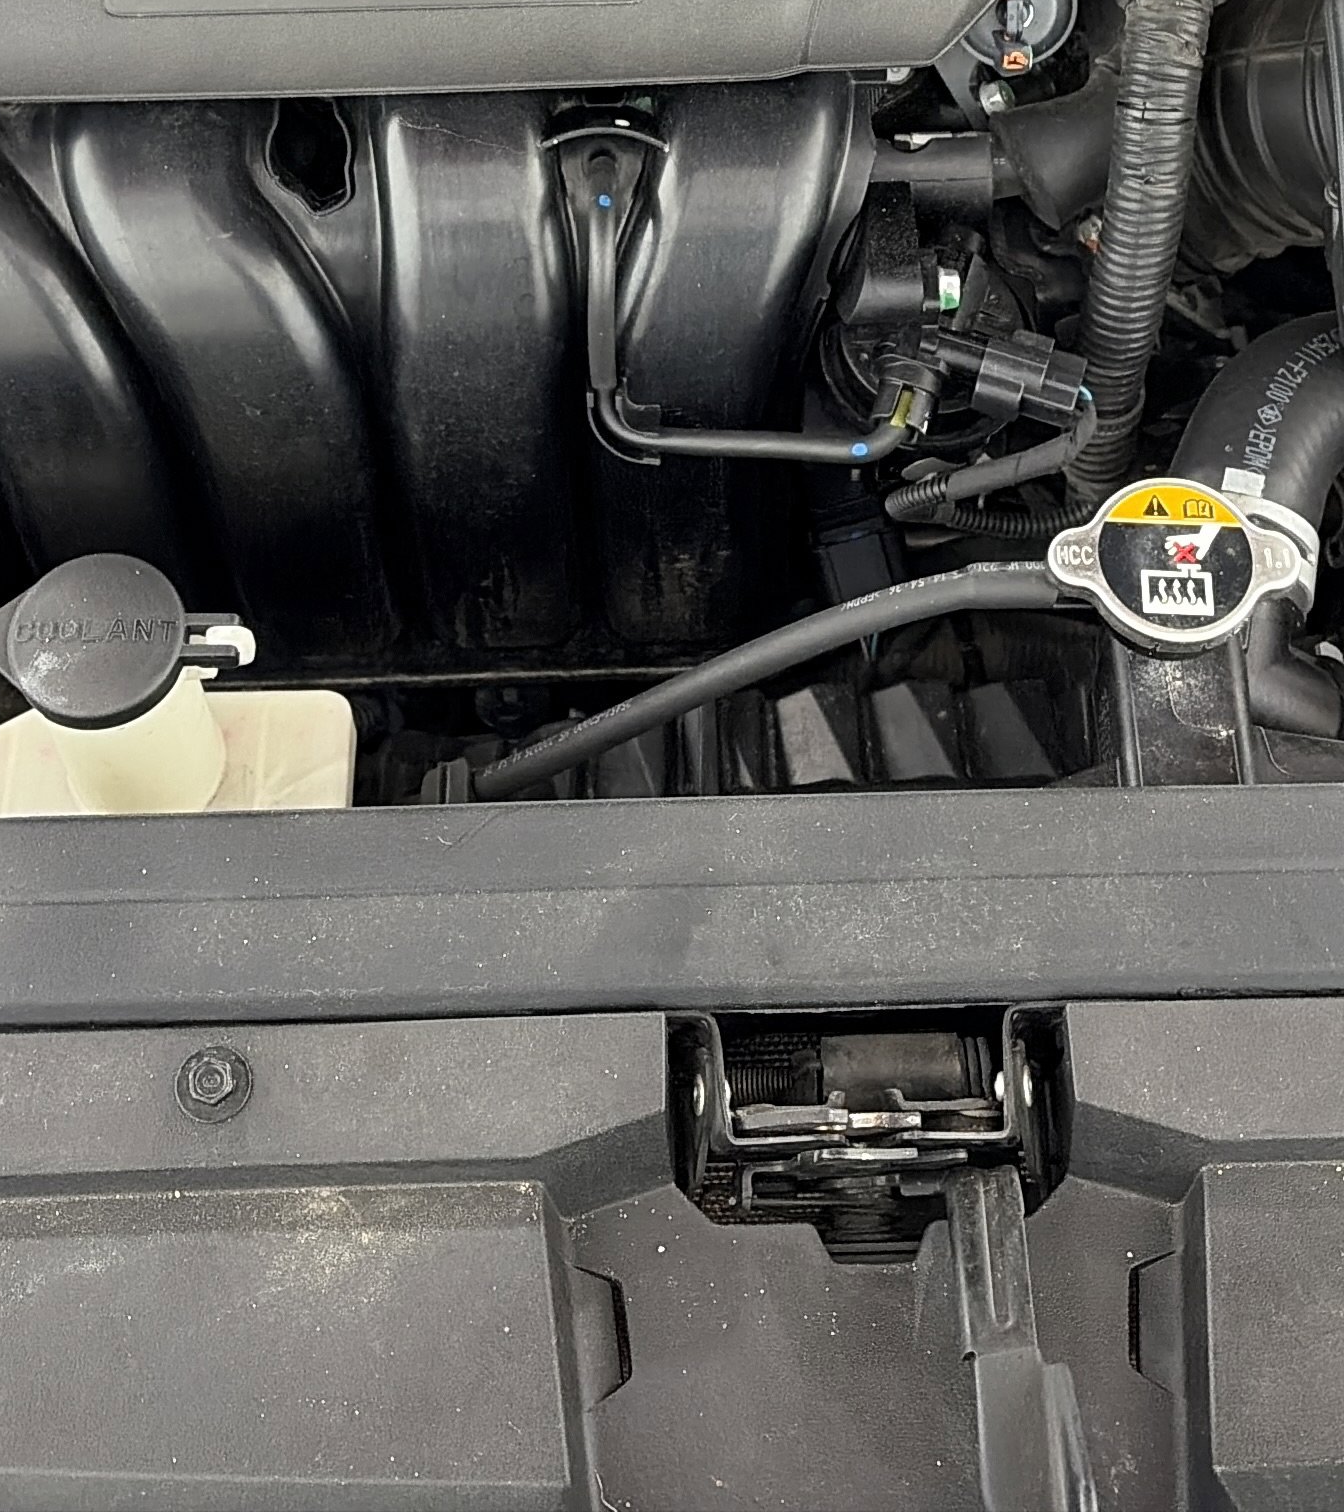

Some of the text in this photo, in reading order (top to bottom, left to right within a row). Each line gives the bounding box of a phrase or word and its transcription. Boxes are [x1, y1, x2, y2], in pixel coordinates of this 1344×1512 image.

[1055, 542, 1097, 568] HCC
[1263, 547, 1292, 570] 1.1
[15, 618, 179, 642] COOLANT
